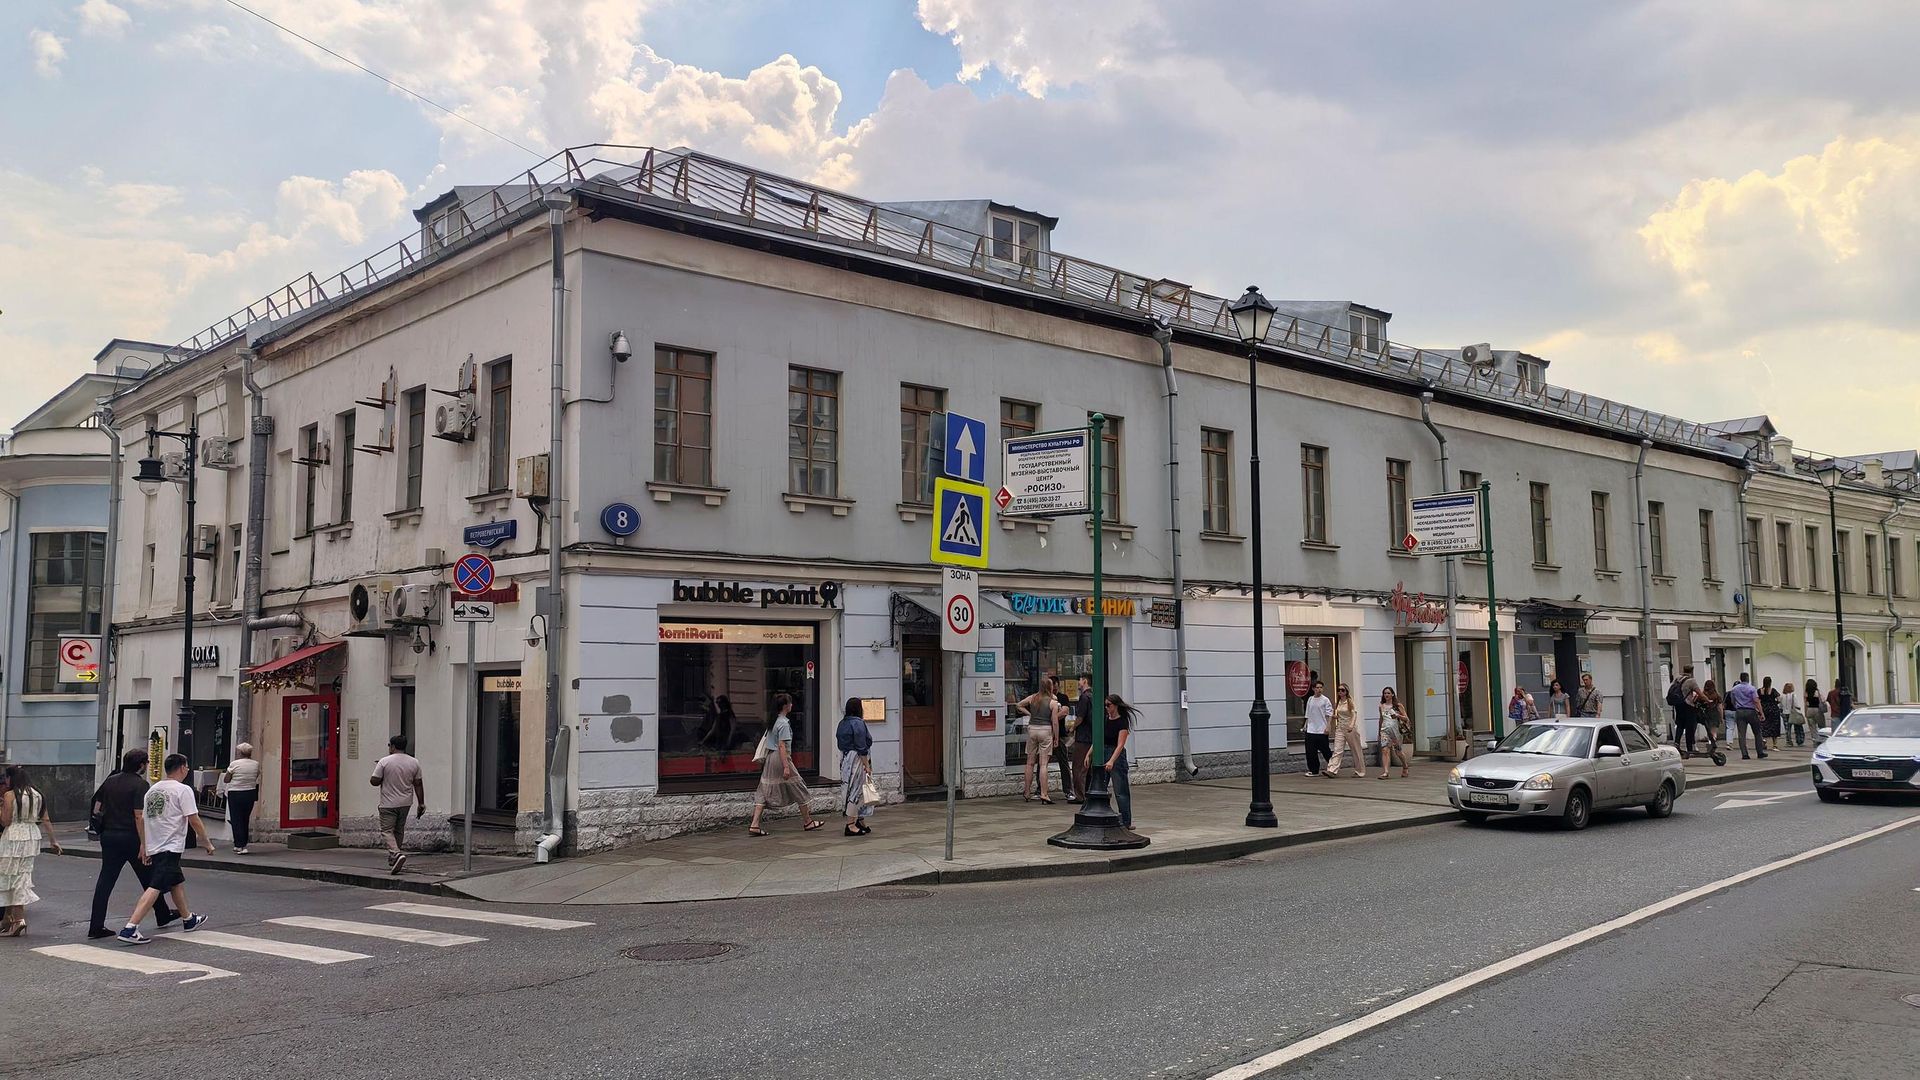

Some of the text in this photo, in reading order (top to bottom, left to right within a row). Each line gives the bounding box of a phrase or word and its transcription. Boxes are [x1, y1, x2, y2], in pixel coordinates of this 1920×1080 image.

[1018, 458, 1072, 469] ГОСУДАРСТВЕННЫЙ
[1011, 464, 1080, 476] МУЗЕЙНО-ВЫСТАВОЧНЫЙ
[1012, 502, 1054, 510] ПЕТРОВЕРИГСКИЙ
[616, 510, 628, 528] 8
[950, 570, 971, 581] ЗОНА
[673, 580, 818, 608] bubble point
[954, 606, 968, 622] 30
[1544, 619, 1568, 629] БИЗНЕС
[497, 679, 514, 688] bubble
